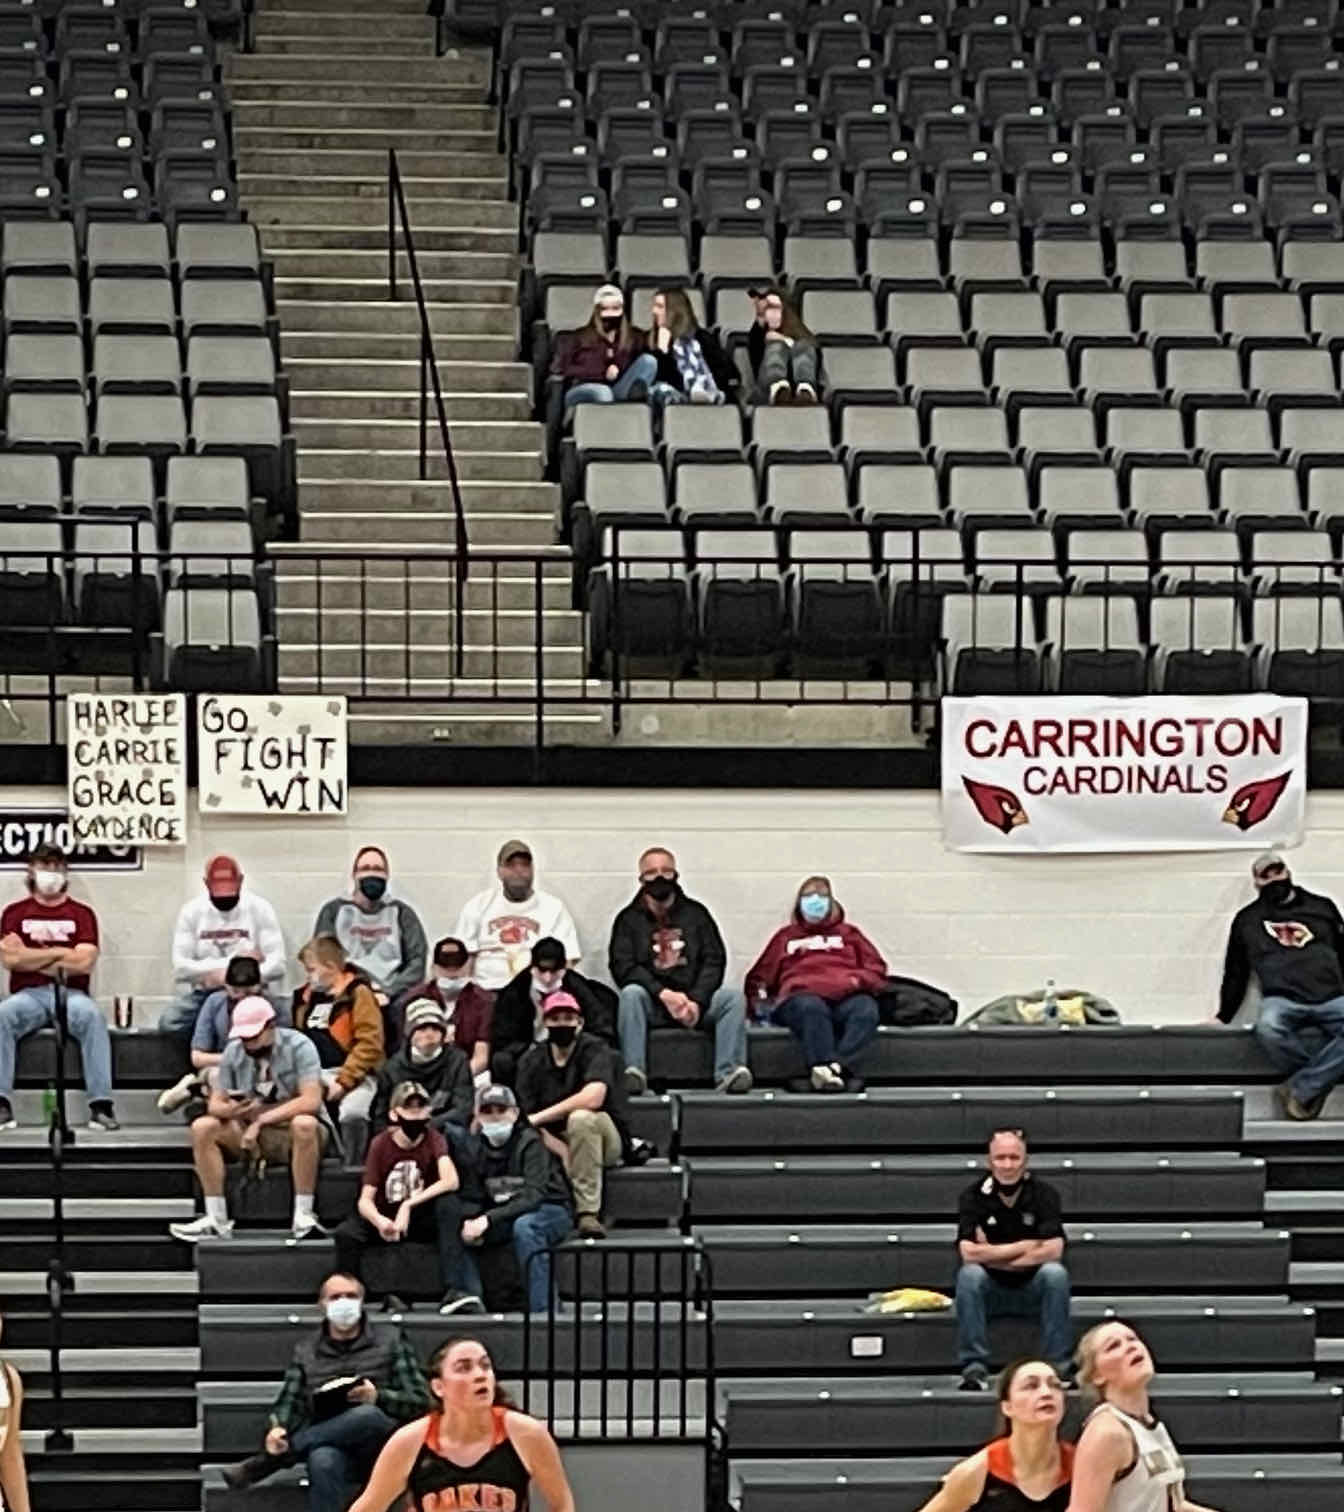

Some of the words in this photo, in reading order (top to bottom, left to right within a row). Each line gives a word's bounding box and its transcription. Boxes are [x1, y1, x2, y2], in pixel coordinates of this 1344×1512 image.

[74, 699, 179, 728] HARLEE
[964, 715, 1284, 758] CARRINGTON
[74, 738, 181, 767] CARRIE
[214, 734, 337, 774] FIGHT
[73, 776, 176, 807] GRACE
[256, 778, 344, 812] WIN
[1022, 764, 1229, 795] CARDINALS
[71, 814, 181, 841] KAYDENCE
